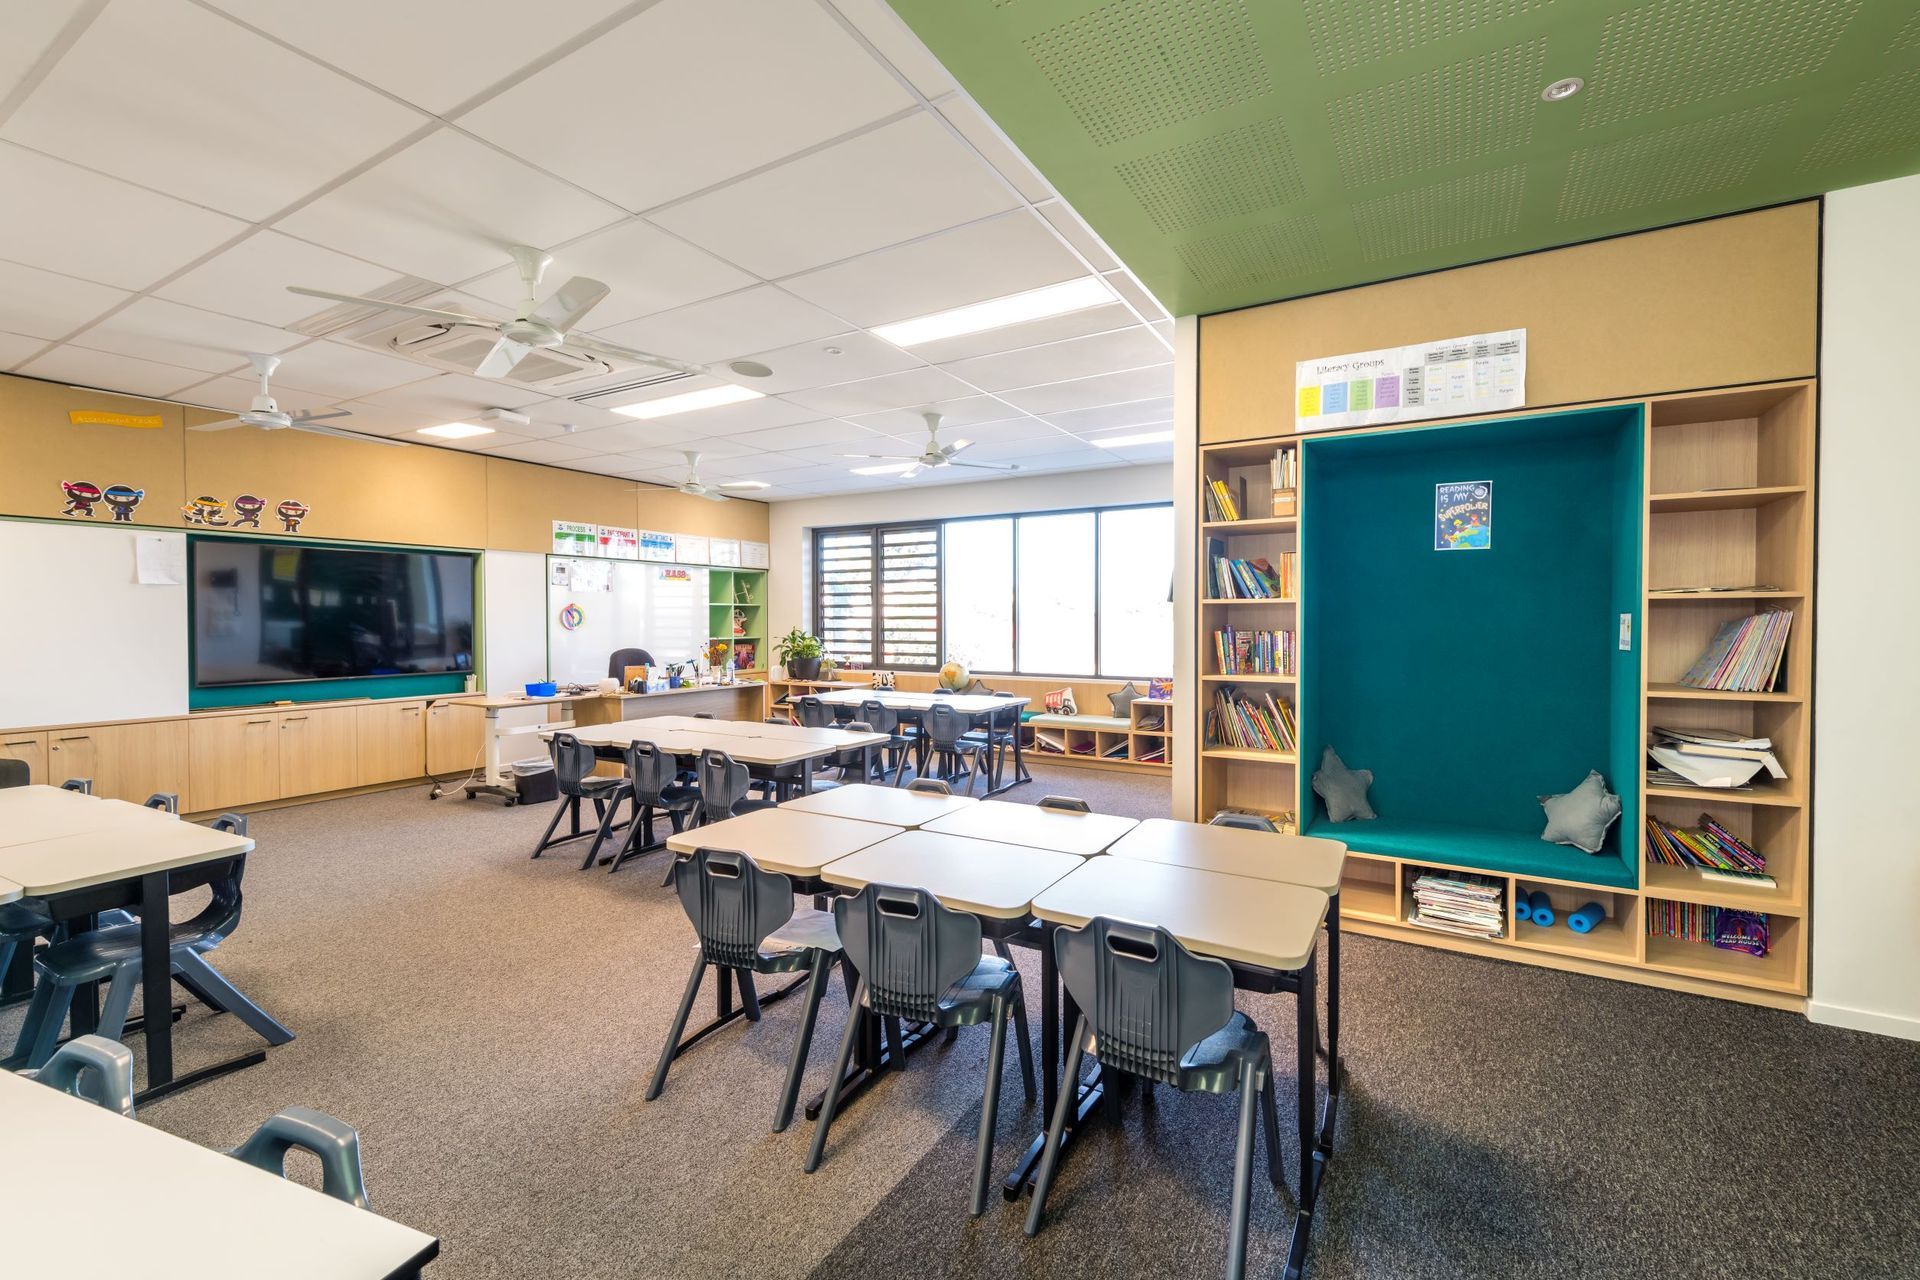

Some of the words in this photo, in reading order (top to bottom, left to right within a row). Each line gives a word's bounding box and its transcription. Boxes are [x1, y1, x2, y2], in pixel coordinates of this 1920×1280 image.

[1316, 363, 1349, 375] Literacy
[1352, 359, 1385, 371] Groups
[1440, 485, 1475, 494] READING
[1440, 495, 1448, 503] IS
[1454, 493, 1468, 502] MY
[1438, 501, 1488, 522] SUPERPOWER
[567, 525, 586, 533] PROCESS
[1721, 933, 1752, 941] WELCOME
